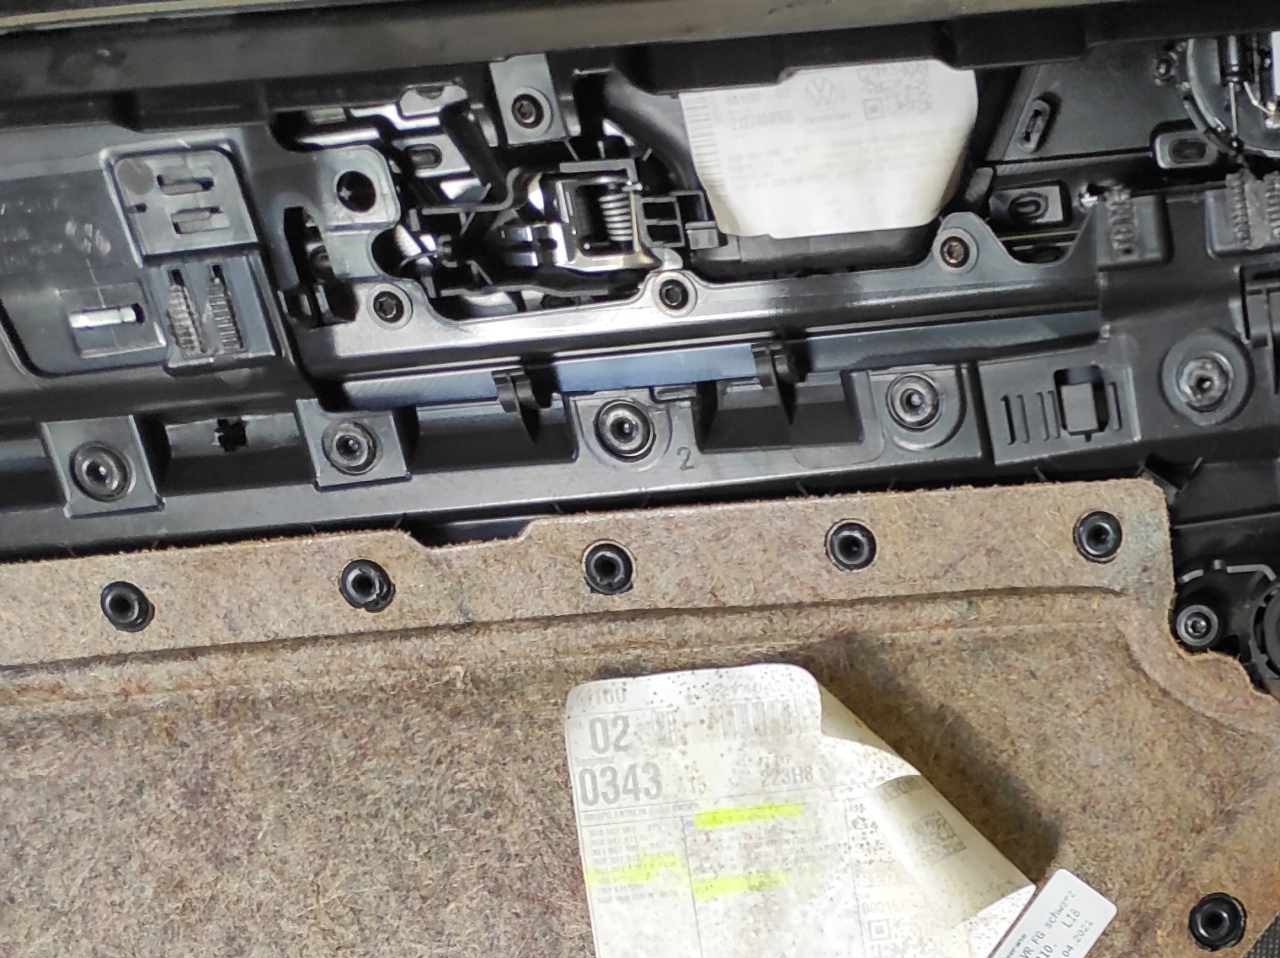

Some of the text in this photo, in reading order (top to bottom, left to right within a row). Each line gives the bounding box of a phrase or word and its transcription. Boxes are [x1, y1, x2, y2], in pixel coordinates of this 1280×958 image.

[677, 446, 695, 471] 2
[588, 715, 630, 755] 02
[578, 762, 663, 807] 0343
[1030, 930, 1045, 946] FG
[1045, 890, 1077, 930] schwarz
